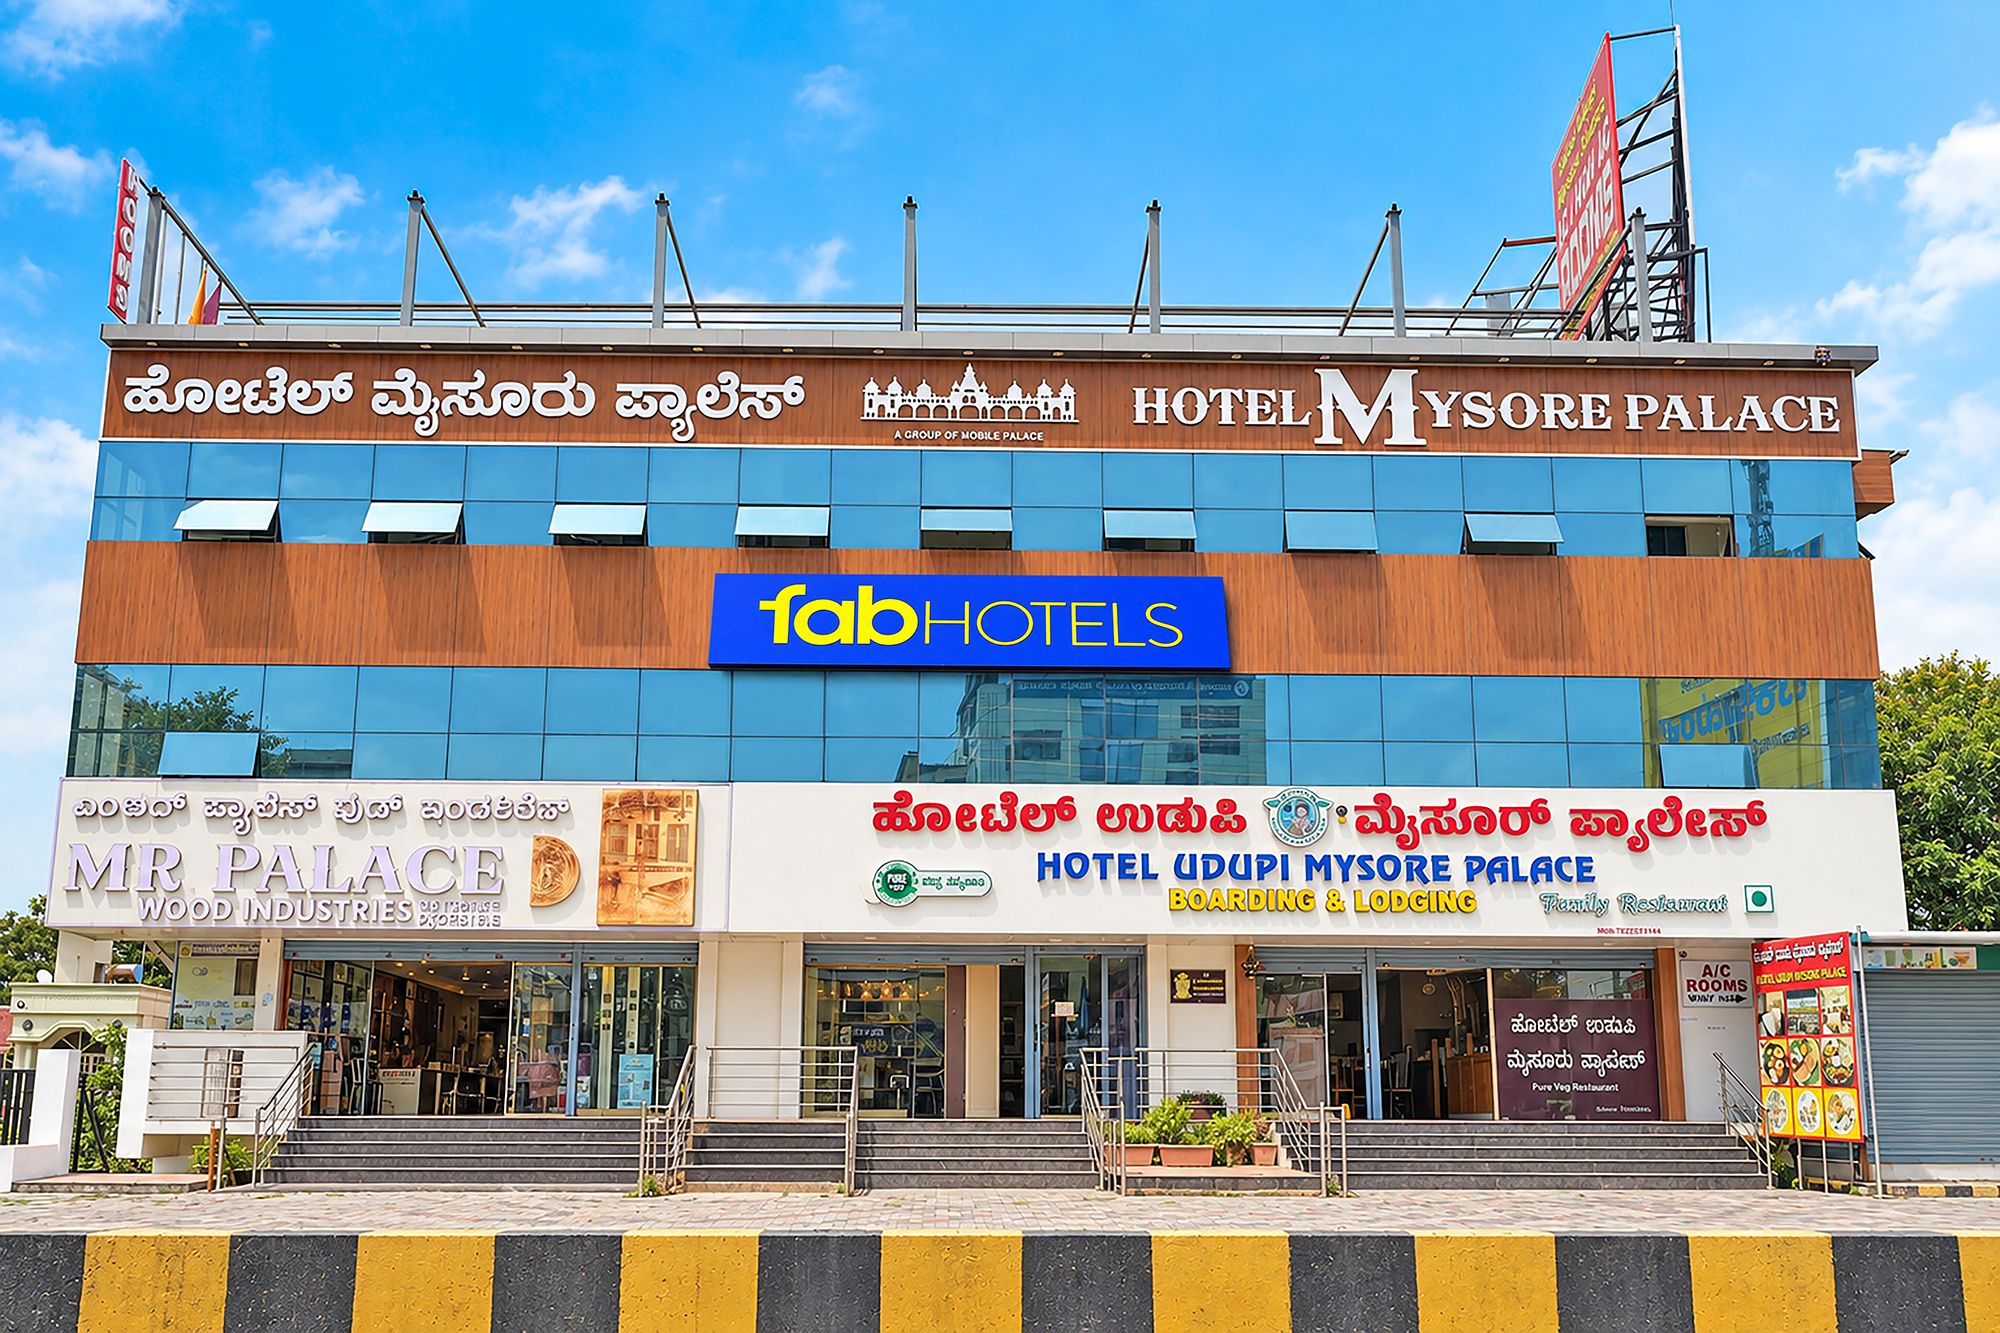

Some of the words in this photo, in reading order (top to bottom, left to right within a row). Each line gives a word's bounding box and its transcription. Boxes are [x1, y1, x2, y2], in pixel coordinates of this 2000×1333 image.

[123, 363, 355, 414] ಹೋಟೆಲ್
[371, 367, 596, 437] ಮೈಸೂರು
[1132, 387, 1312, 427] HOTEL
[1313, 367, 1613, 446] MYSORE
[1624, 393, 1841, 433] PALACE
[893, 430, 902, 439] A
[904, 430, 942, 440] GROUP
[944, 430, 959, 440] OF
[960, 430, 1001, 441] MOBILE
[1002, 431, 1044, 441] PALACE
[873, 790, 1077, 833] ಹೋಟೆಲ್
[1096, 796, 1247, 834] ಉಡುಪಿ
[1354, 792, 1551, 851] ಮೈಸೂರ್
[1569, 795, 1768, 853] ಪ್ಯಾಲೇಸ್
[64, 843, 181, 892] MR
[212, 845, 504, 896] PALACE
[1036, 851, 1159, 882] HOTEL
[1173, 852, 1290, 882] UDUPI
[1304, 854, 1451, 885] MYSORE
[1465, 855, 1597, 885] PALACE
[138, 898, 233, 922] WOOD
[243, 899, 413, 923] INDUSTRIES
[1169, 887, 1317, 912] BOARDING
[1326, 888, 1345, 913] &
[1354, 889, 1478, 914] LODGING
[1702, 963, 1731, 978] A/C
[1686, 979, 1748, 993] ROOMS
[1532, 1083, 1552, 1092] Pure
[1553, 1083, 1571, 1093] Veg
[1572, 1083, 1619, 1092] Restaurant
